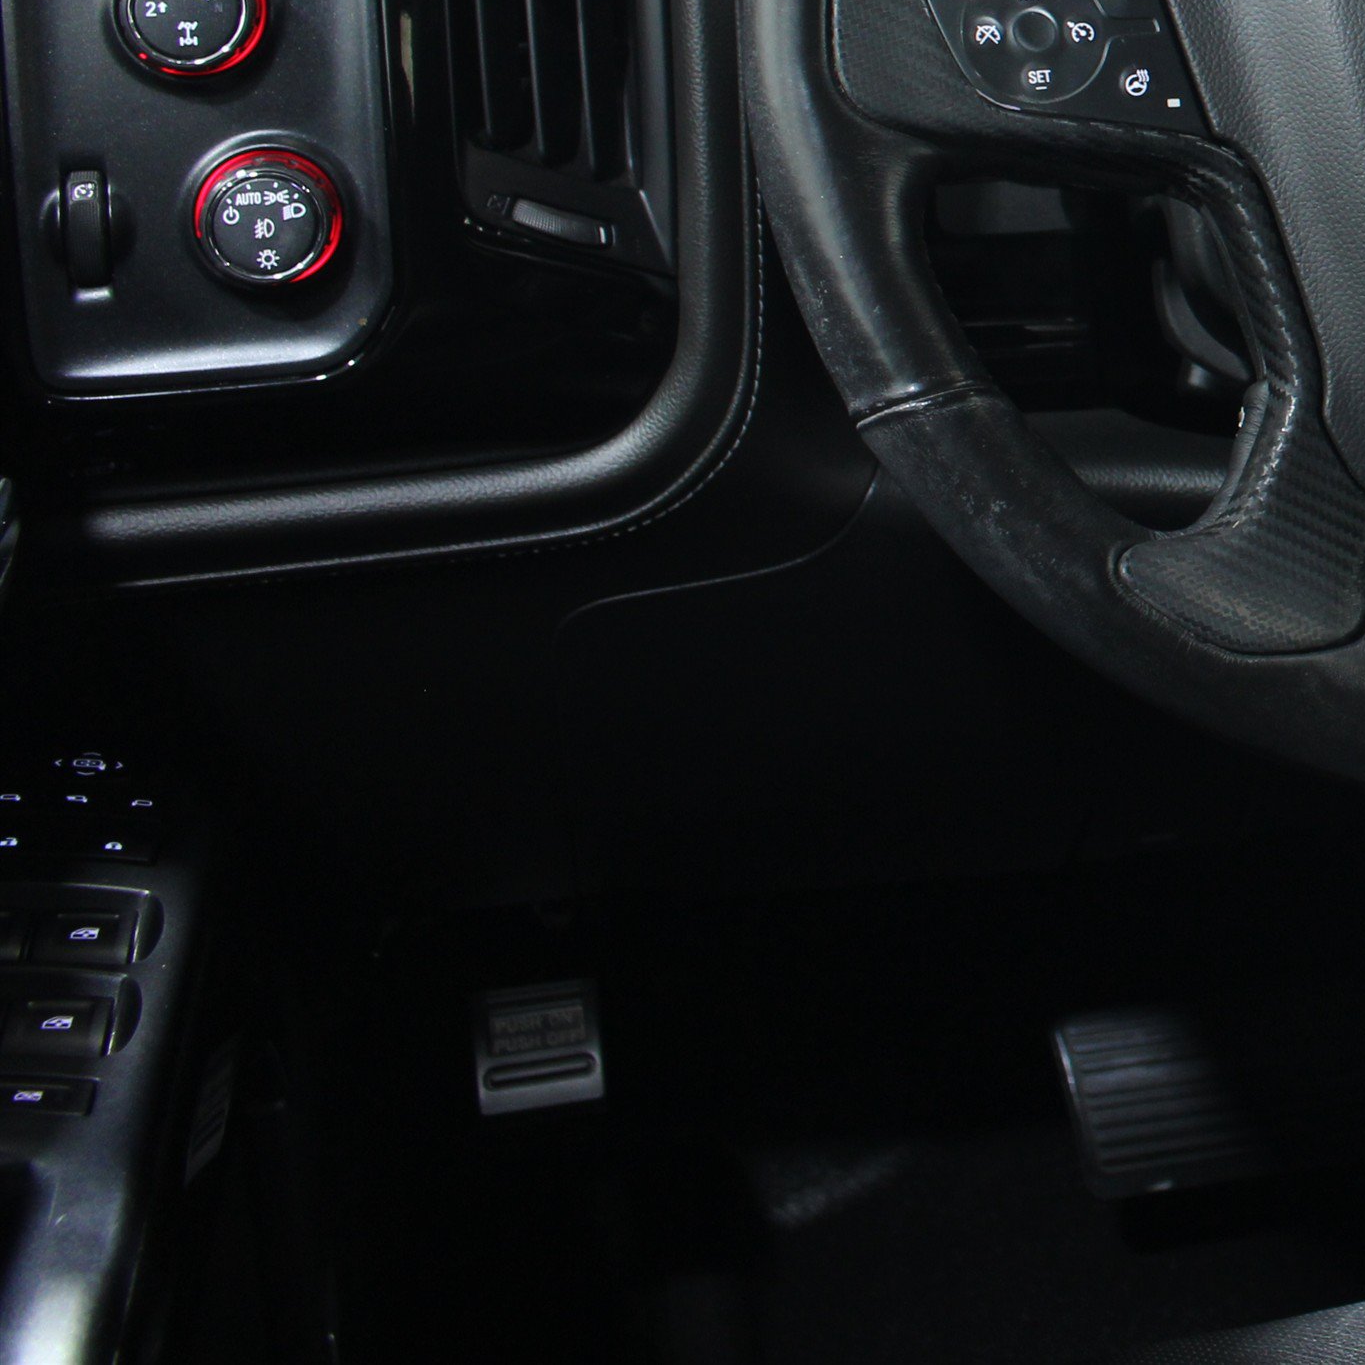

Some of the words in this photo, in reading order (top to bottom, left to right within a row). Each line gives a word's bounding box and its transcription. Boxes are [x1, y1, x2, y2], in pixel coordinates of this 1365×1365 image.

[145, 1, 157, 17] 2
[1027, 69, 1051, 84] SET
[235, 191, 261, 206] AUTO
